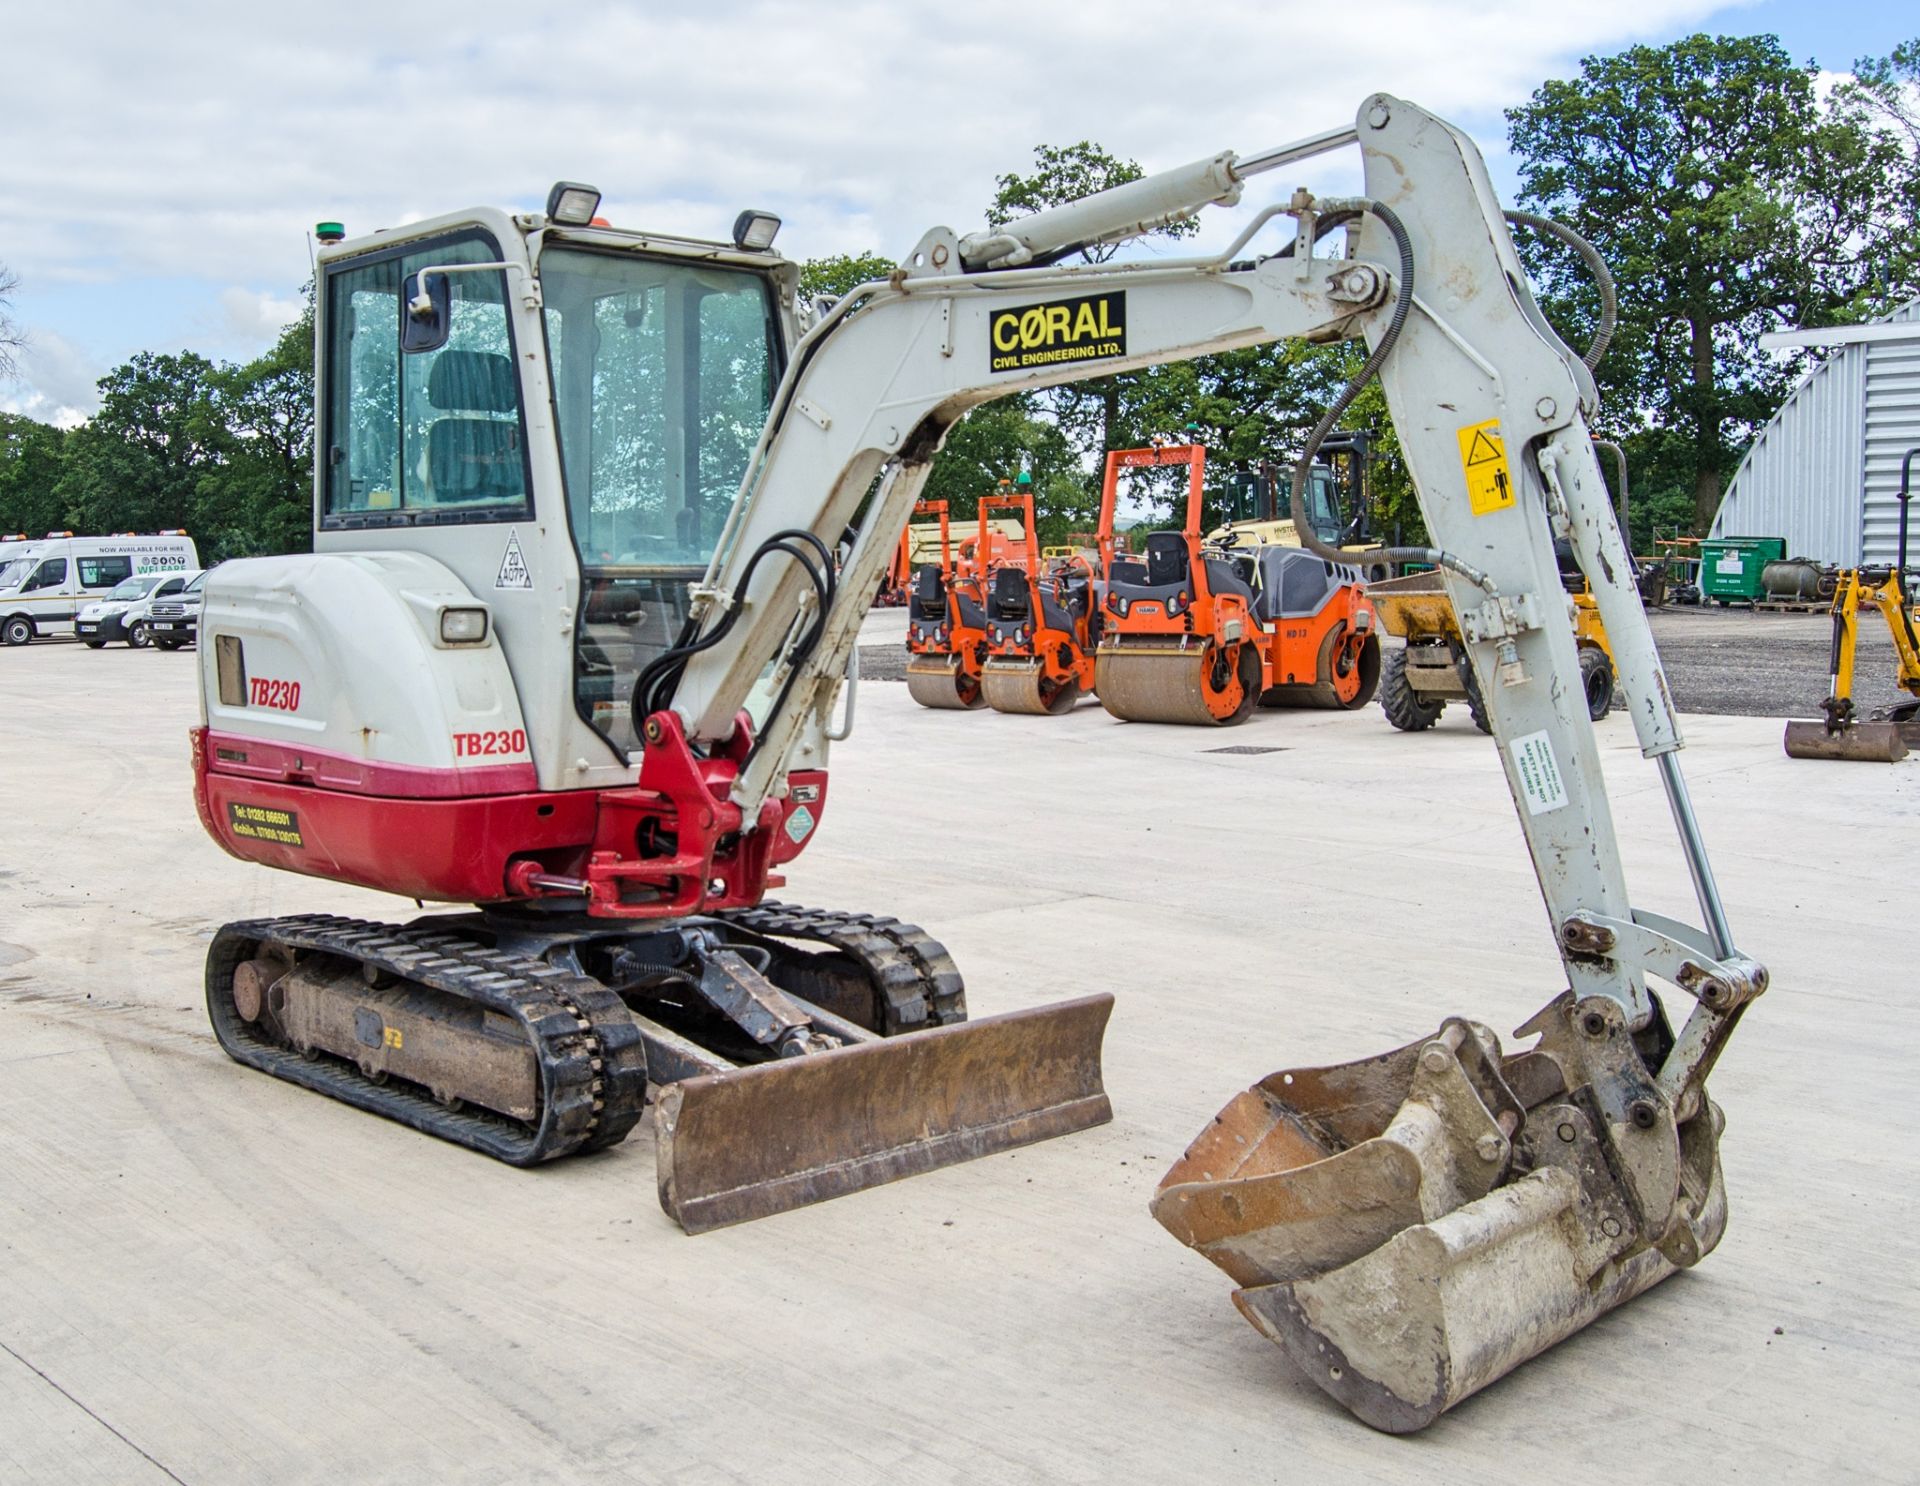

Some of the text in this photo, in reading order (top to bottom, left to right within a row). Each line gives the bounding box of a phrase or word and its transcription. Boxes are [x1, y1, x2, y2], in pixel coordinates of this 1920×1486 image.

[993, 343, 1121, 369] CIVIL ENGINEERING LTD.
[1286, 629, 1297, 639] HD
[251, 677, 301, 711] TB230
[453, 729, 525, 756] TB230
[1520, 757, 1535, 795] REQUIRED
[1524, 743, 1536, 771] SAFETY
[1538, 788, 1547, 803] NOT
[234, 805, 247, 818] Tel:
